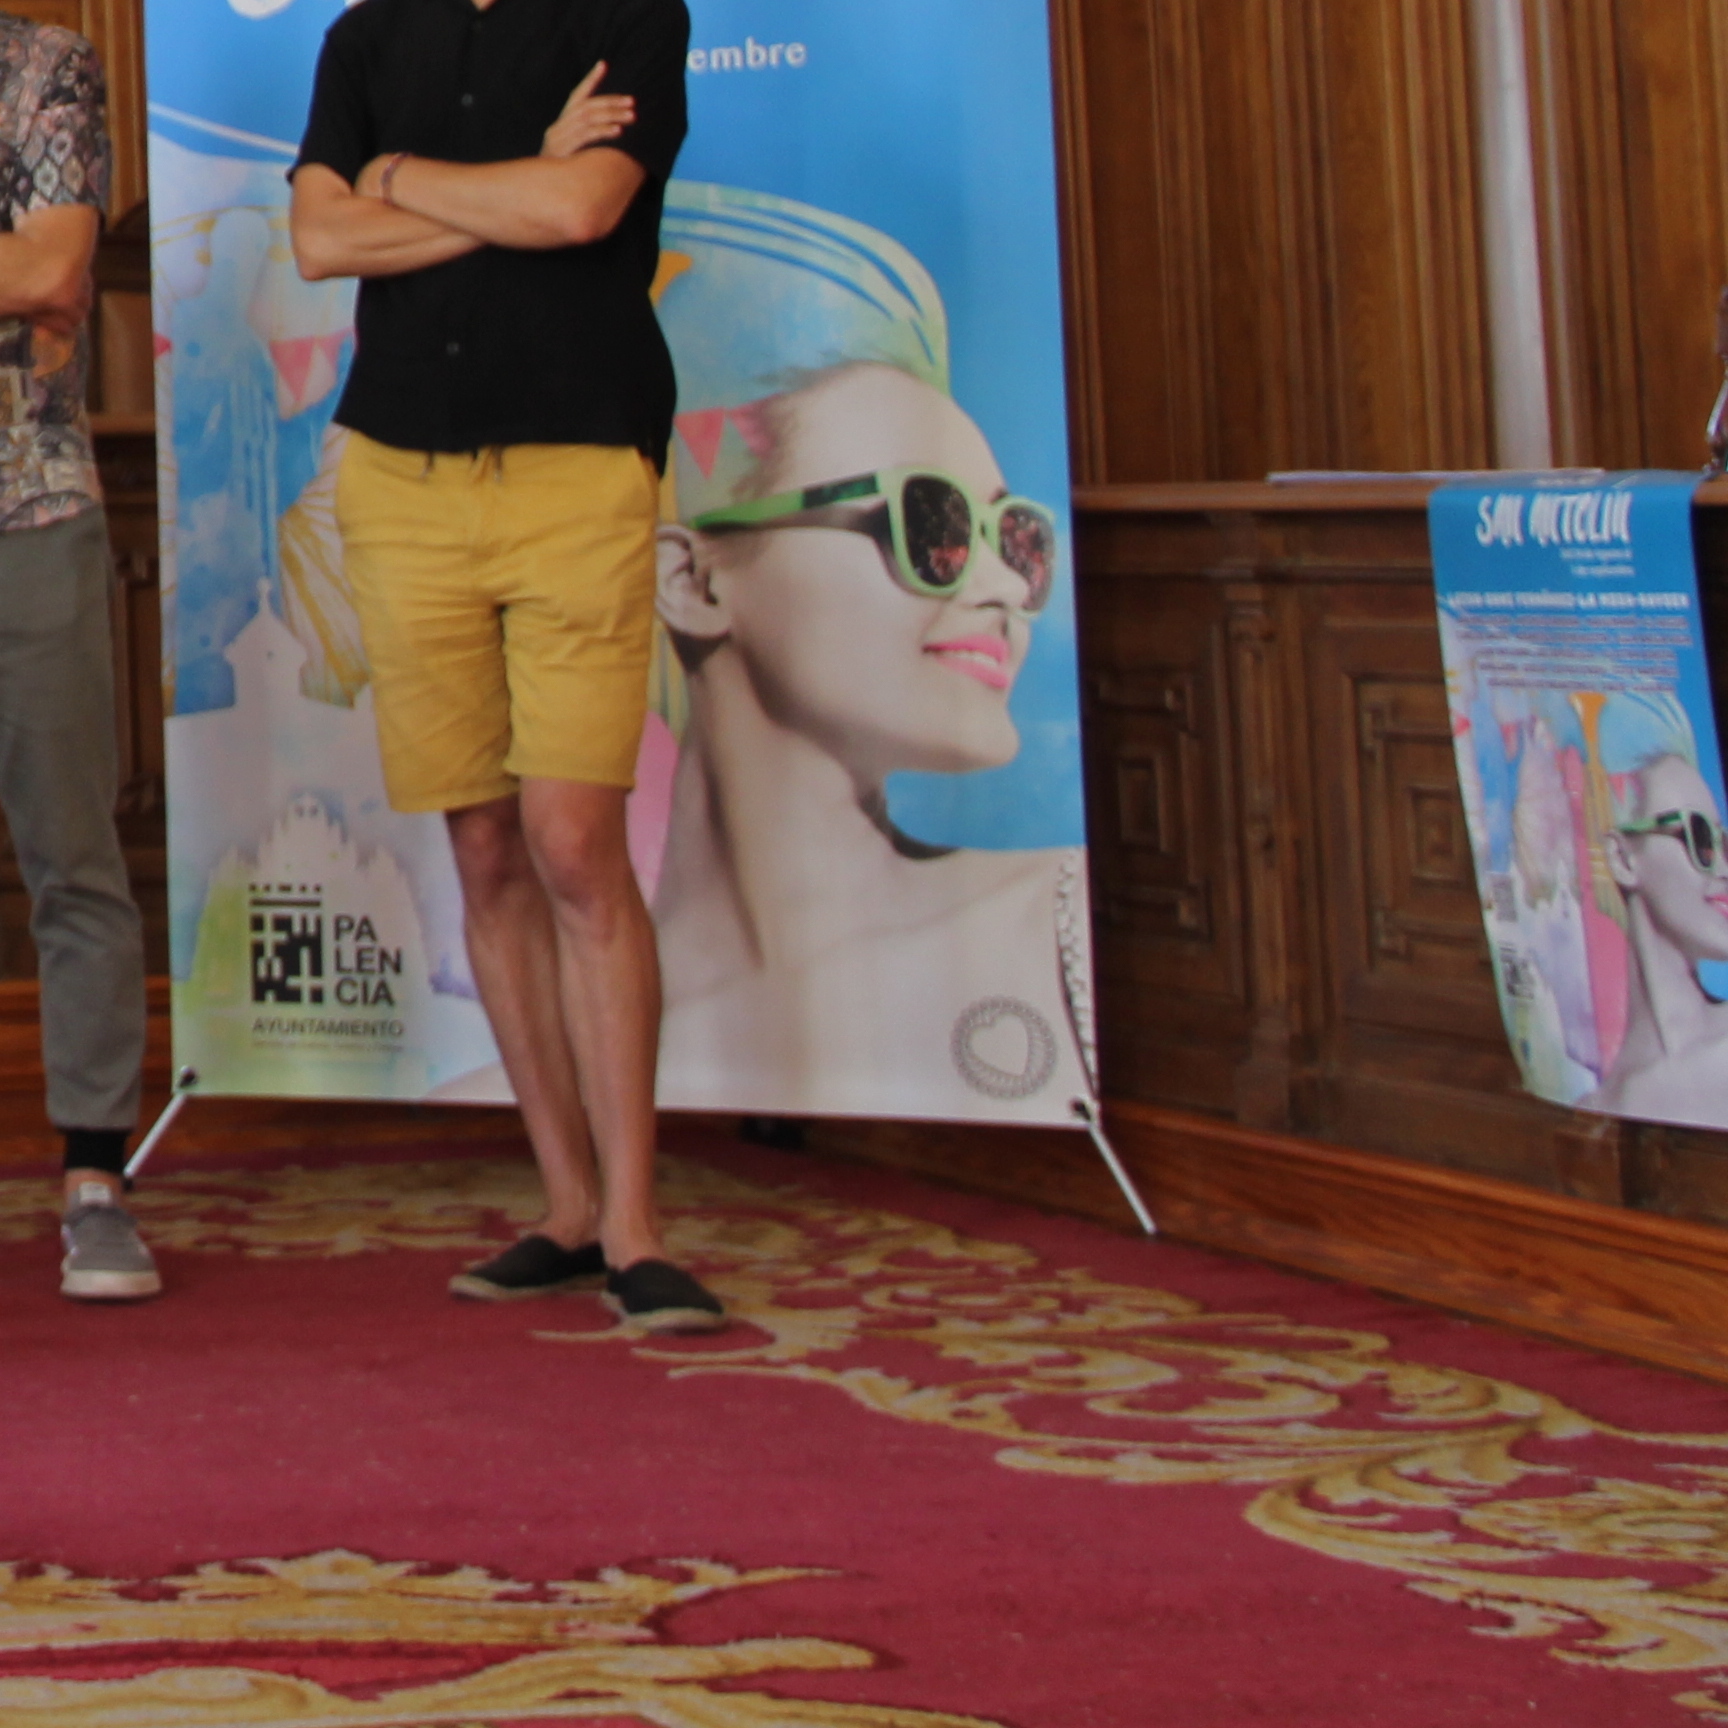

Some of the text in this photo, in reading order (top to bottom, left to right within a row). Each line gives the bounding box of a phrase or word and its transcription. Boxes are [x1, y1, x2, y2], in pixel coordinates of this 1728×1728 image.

[333, 913, 378, 942] PA
[334, 946, 403, 974] LEN
[334, 976, 395, 1007] CIA
